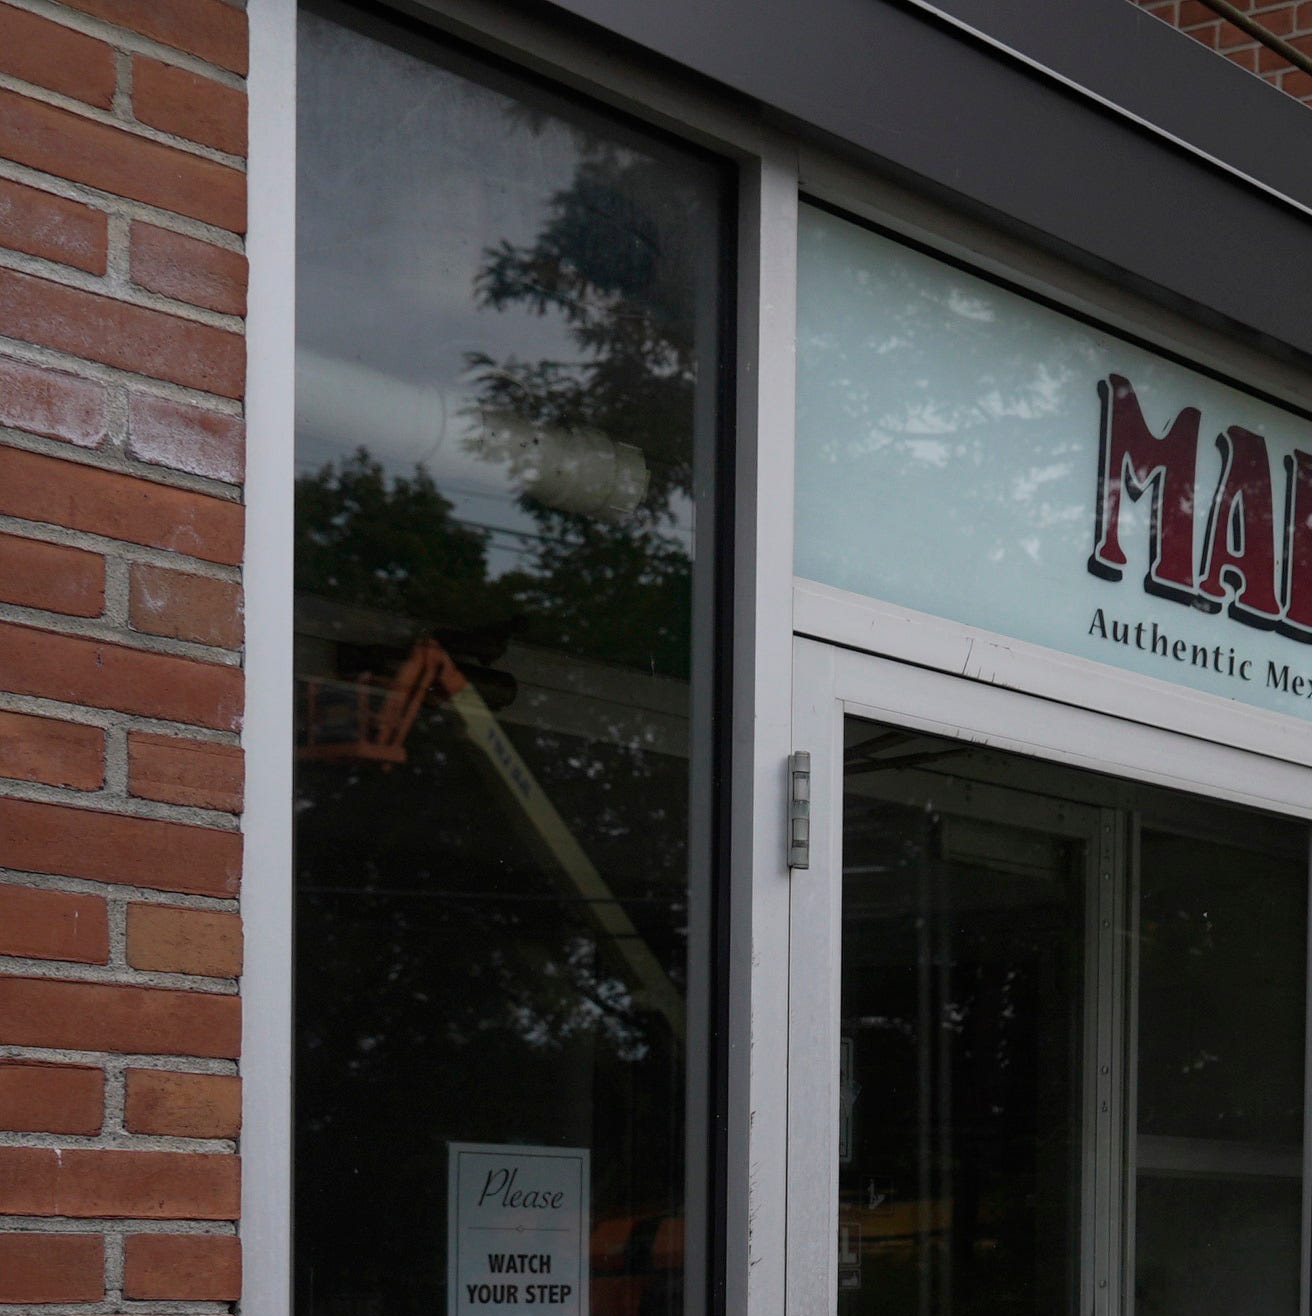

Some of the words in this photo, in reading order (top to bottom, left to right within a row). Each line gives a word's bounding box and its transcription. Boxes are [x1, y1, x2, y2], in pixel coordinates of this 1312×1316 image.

[1088, 608, 1253, 682] Authentic
[478, 1167, 565, 1209] Please
[488, 1253, 551, 1274] WATCH
[466, 1284, 518, 1305] YOUR
[525, 1284, 572, 1304] STEP
